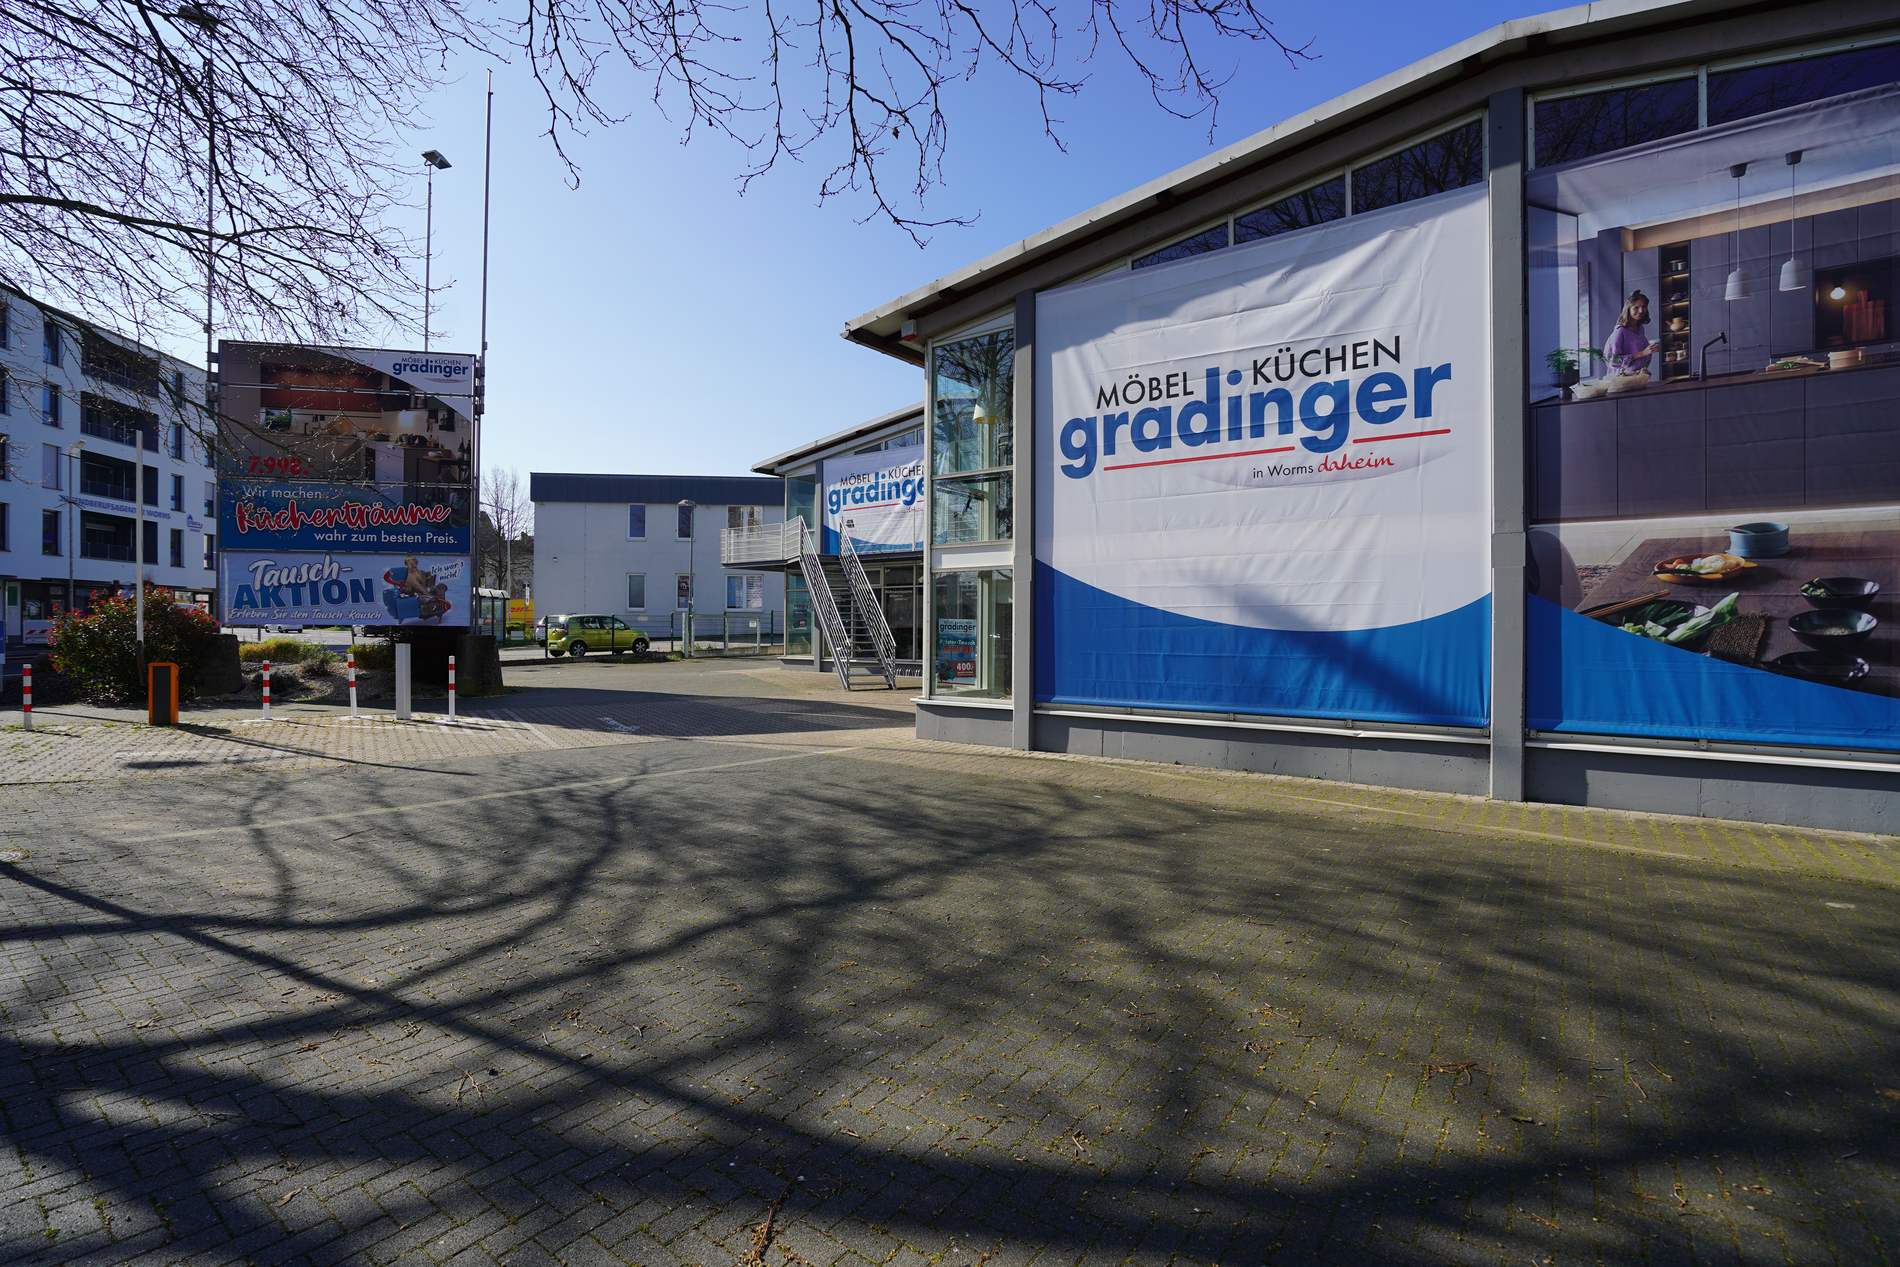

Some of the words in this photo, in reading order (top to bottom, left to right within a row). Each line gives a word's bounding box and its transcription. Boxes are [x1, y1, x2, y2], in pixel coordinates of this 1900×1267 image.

[392, 359, 469, 378] gradinger
[401, 356, 423, 364] MÖBEL
[434, 358, 462, 366] KÜCHEN
[1096, 371, 1194, 409] MÖBEL
[1253, 335, 1400, 386] KÜCHEN
[1060, 362, 1452, 479] gradinger
[1253, 466, 1264, 479] in
[1269, 464, 1314, 478] Worms
[1317, 452, 1395, 474] daheim
[840, 473, 871, 487] MÖBEL
[243, 484, 268, 498] Wir
[236, 500, 452, 534] Küchenträume
[314, 530, 347, 541] wahr
[351, 533, 377, 542] zum
[381, 531, 421, 543] besten
[426, 532, 458, 543] Preis.
[249, 553, 352, 590] Tausch-
[233, 578, 375, 609] AKTION
[230, 608, 267, 619] Erleben
[271, 608, 287, 619] Sie
[939, 621, 976, 632] gradinger
